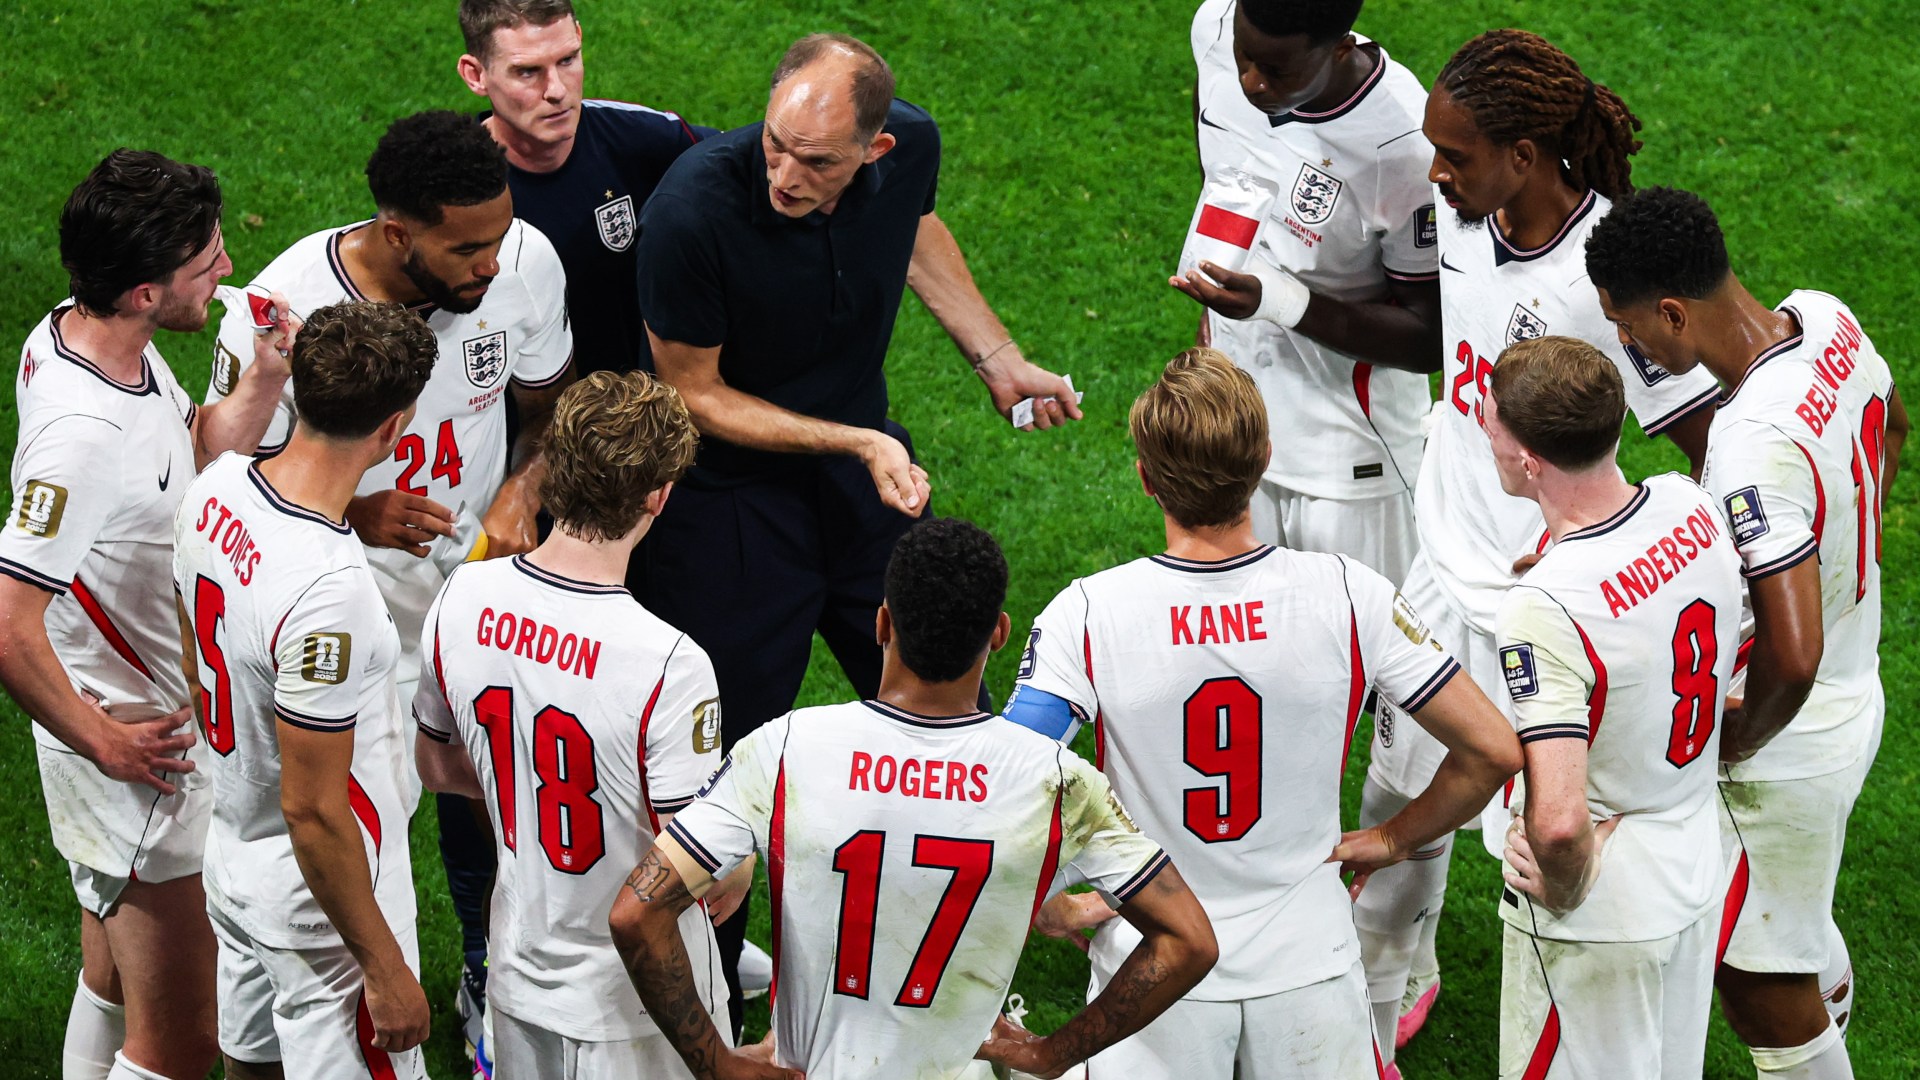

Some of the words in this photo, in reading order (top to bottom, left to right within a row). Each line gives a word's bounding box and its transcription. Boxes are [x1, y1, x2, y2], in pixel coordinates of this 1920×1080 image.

[1284, 216, 1323, 243] ARGENTINA
[468, 384, 504, 407] ARGENTINA
[1794, 310, 1863, 439] BELNGHAM
[394, 418, 463, 498] 24
[196, 496, 262, 587] STONES
[1599, 503, 1720, 619] ANDERSON
[195, 572, 236, 757] 5
[477, 607, 602, 680] GORDON
[1170, 600, 1267, 645] KANE
[313, 673, 337, 681] 2026
[1665, 597, 1718, 769] 8
[473, 685, 606, 875] 18
[849, 751, 988, 803] ROGERS
[1183, 675, 1263, 844] 9
[832, 829, 994, 1008] 17
